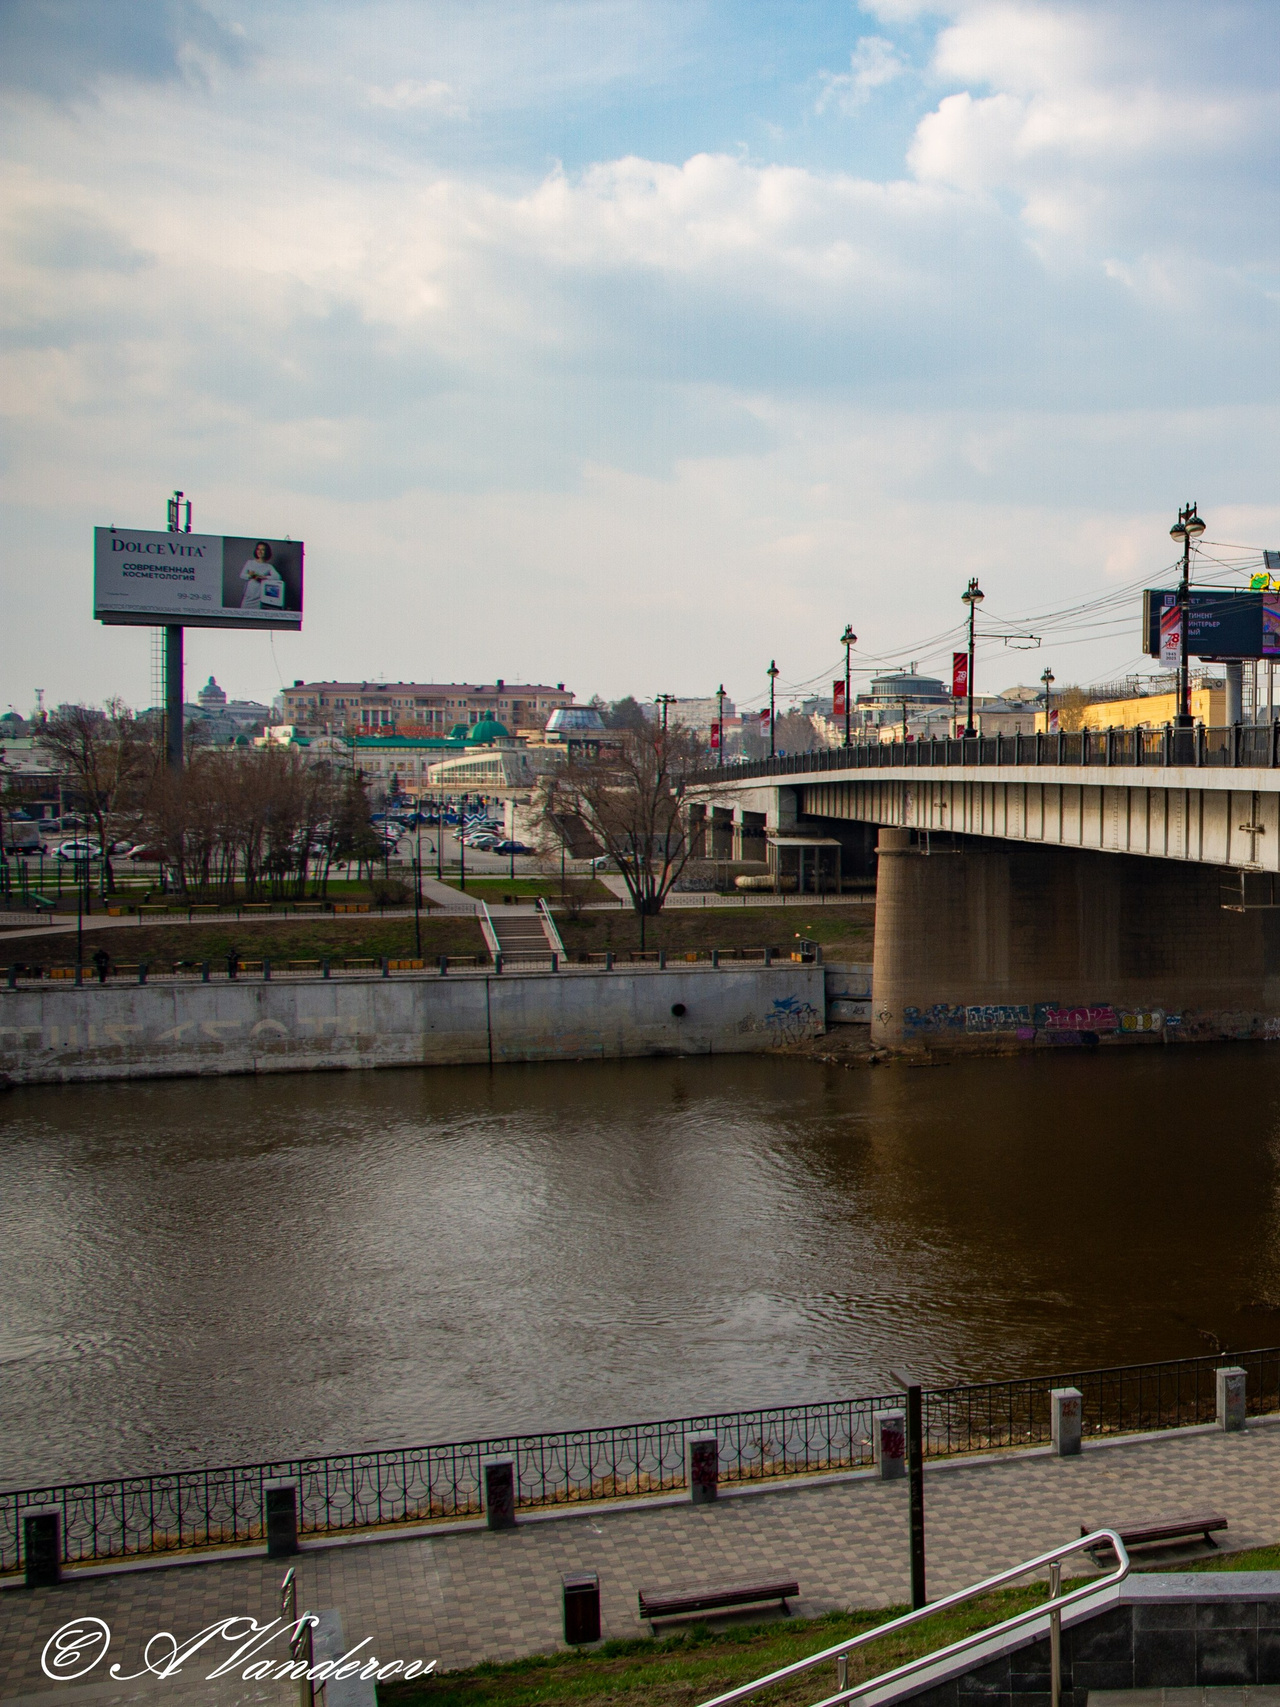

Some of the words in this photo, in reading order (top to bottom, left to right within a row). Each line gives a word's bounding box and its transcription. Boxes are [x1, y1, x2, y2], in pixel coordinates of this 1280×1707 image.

[112, 539, 165, 555] DOLCE
[122, 563, 195, 574] СОВРЕМЕННАЯ
[122, 571, 196, 581] КОСМЕТОЛОГИЯ
[177, 593, 213, 601] 99-29-85
[1168, 633, 1180, 643] 78
[355, 725, 394, 736] DNS
